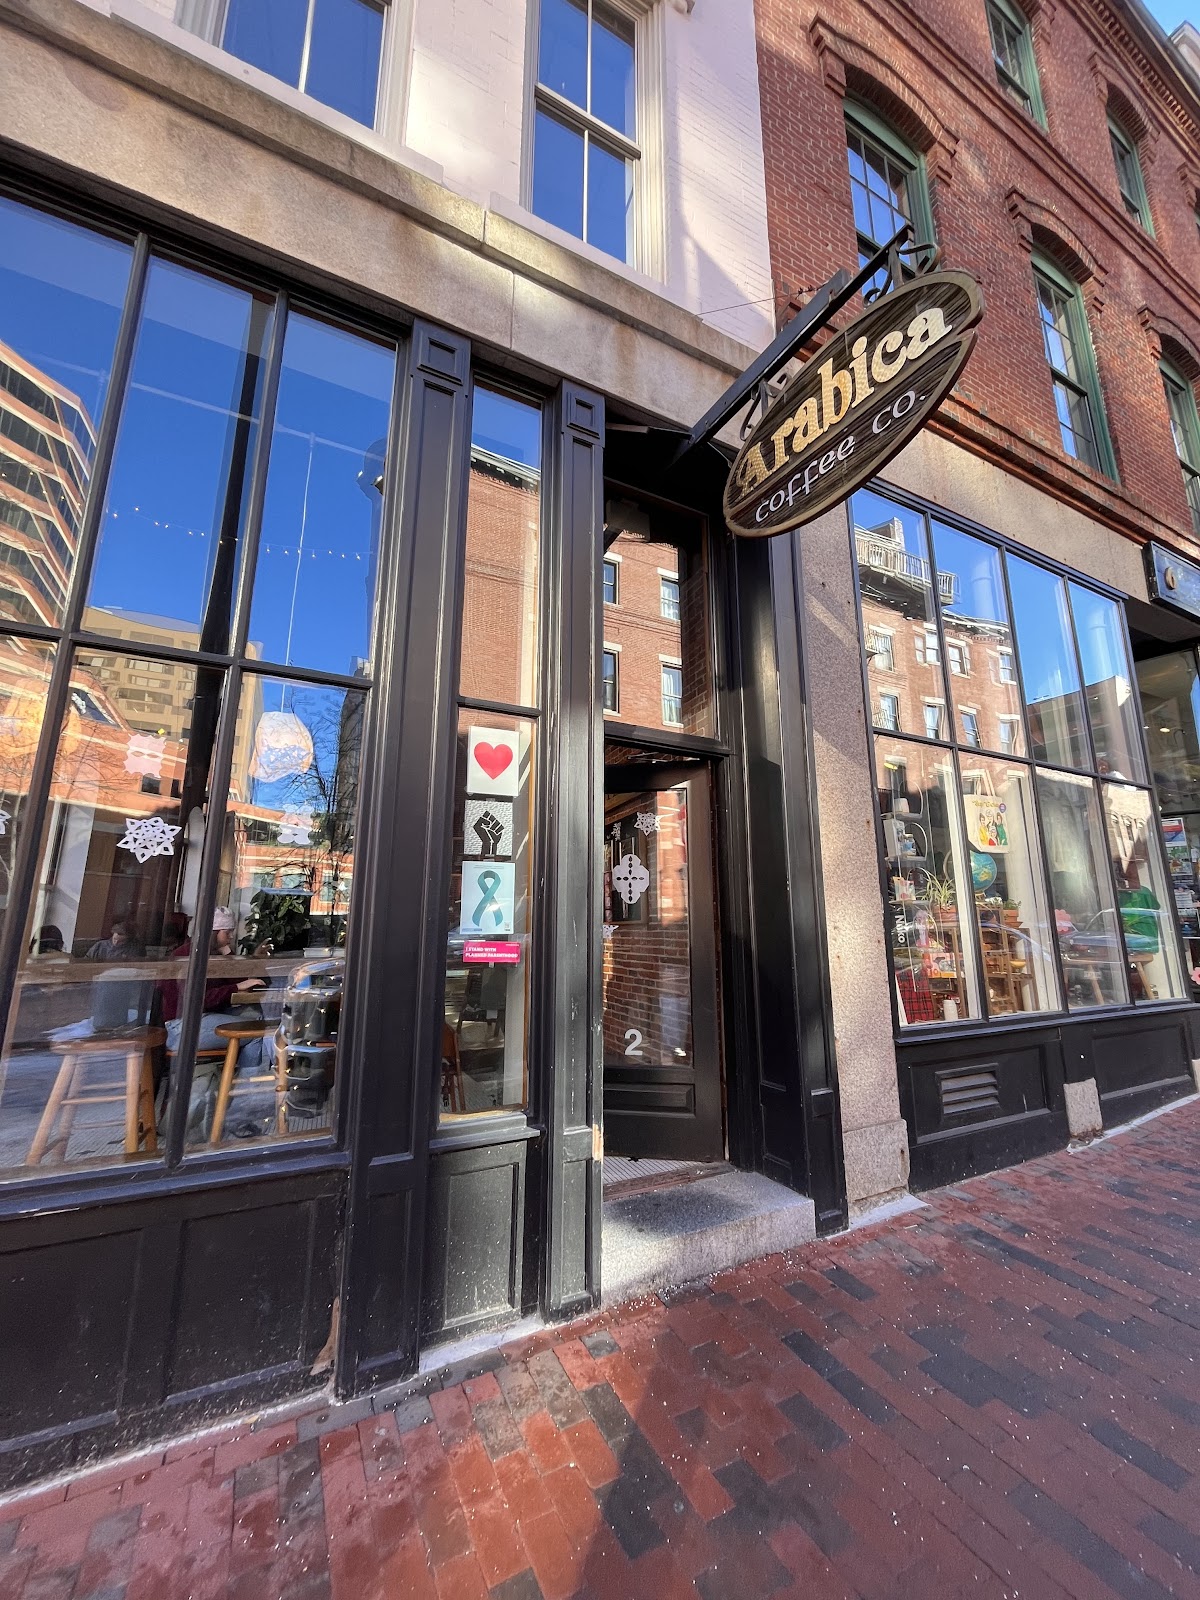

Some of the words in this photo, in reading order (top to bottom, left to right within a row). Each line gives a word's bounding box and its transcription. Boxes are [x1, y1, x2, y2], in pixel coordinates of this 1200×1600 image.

[736, 307, 953, 497] Arabica
[755, 434, 855, 523] coffee
[624, 1028, 643, 1056] 2
